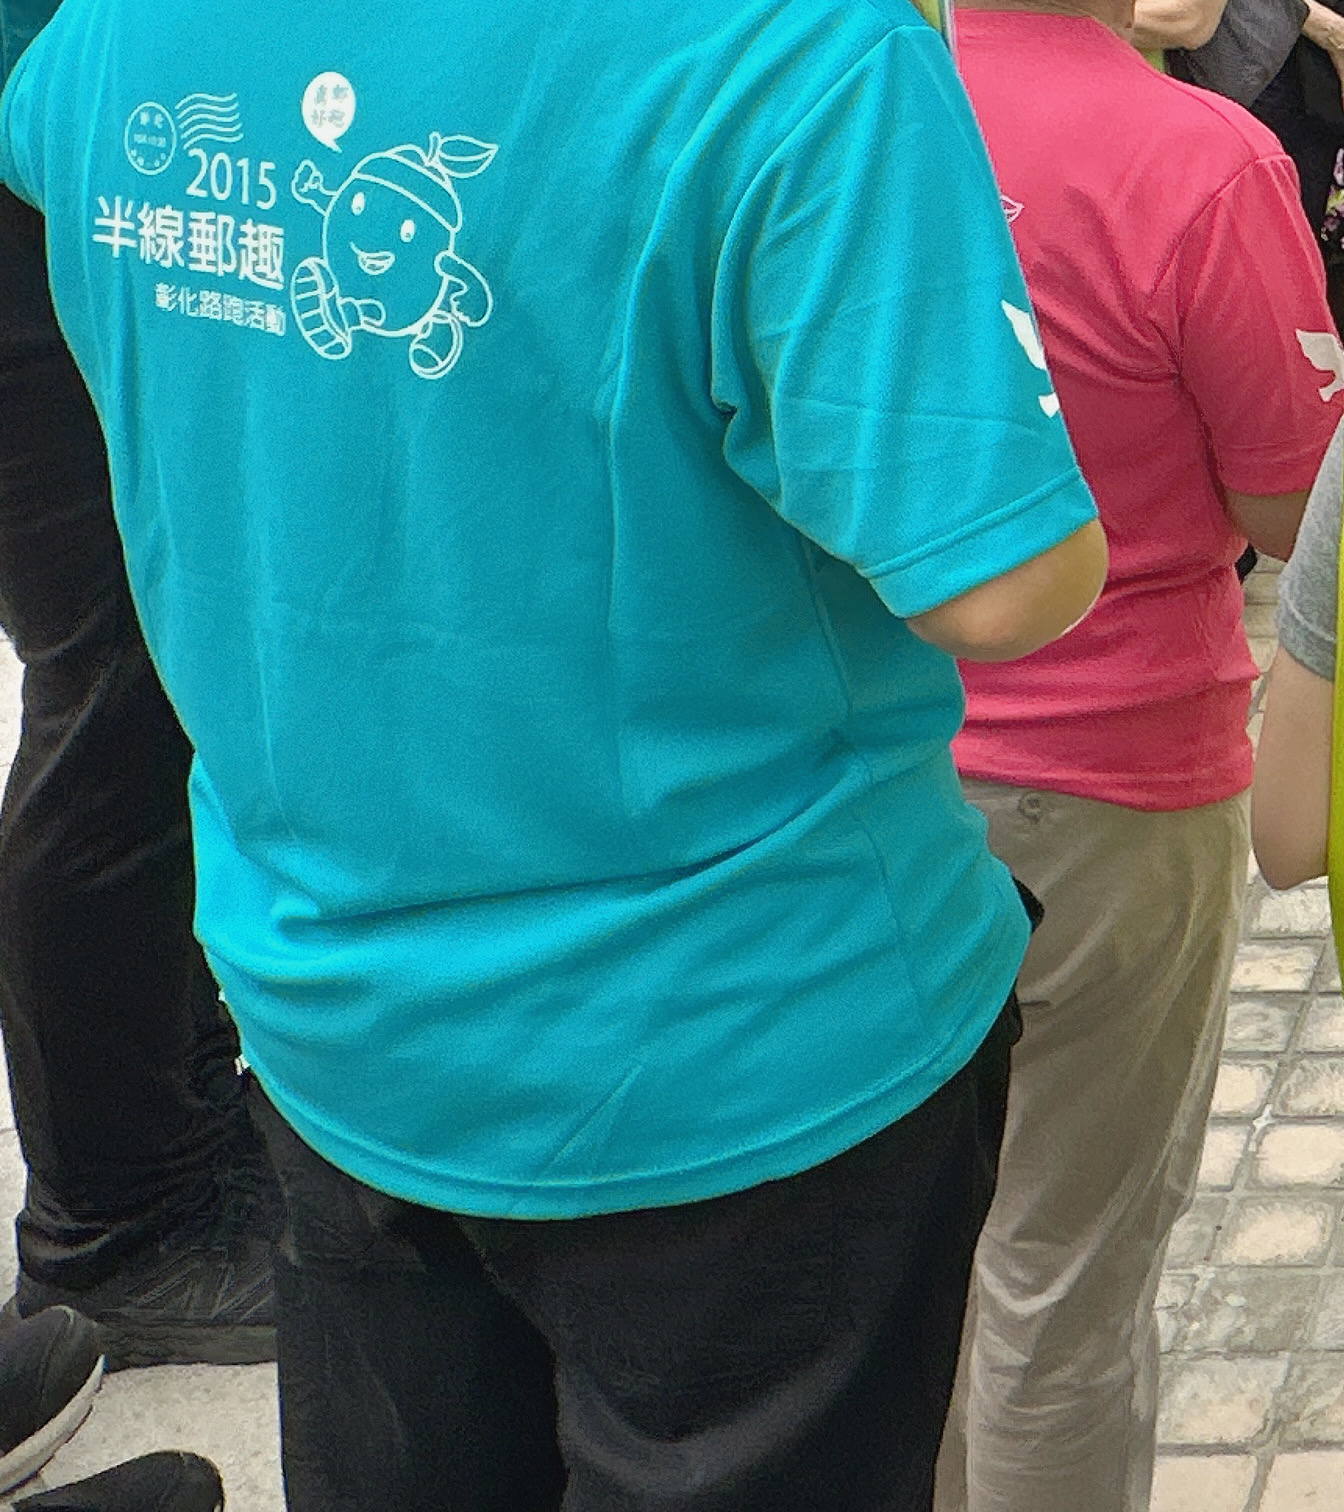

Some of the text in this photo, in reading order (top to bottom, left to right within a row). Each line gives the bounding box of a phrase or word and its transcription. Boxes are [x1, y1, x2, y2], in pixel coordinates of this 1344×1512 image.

[186, 148, 277, 210] 2015
[93, 195, 285, 289] 半線郵趣
[155, 283, 287, 336] 彰化路跑活動
